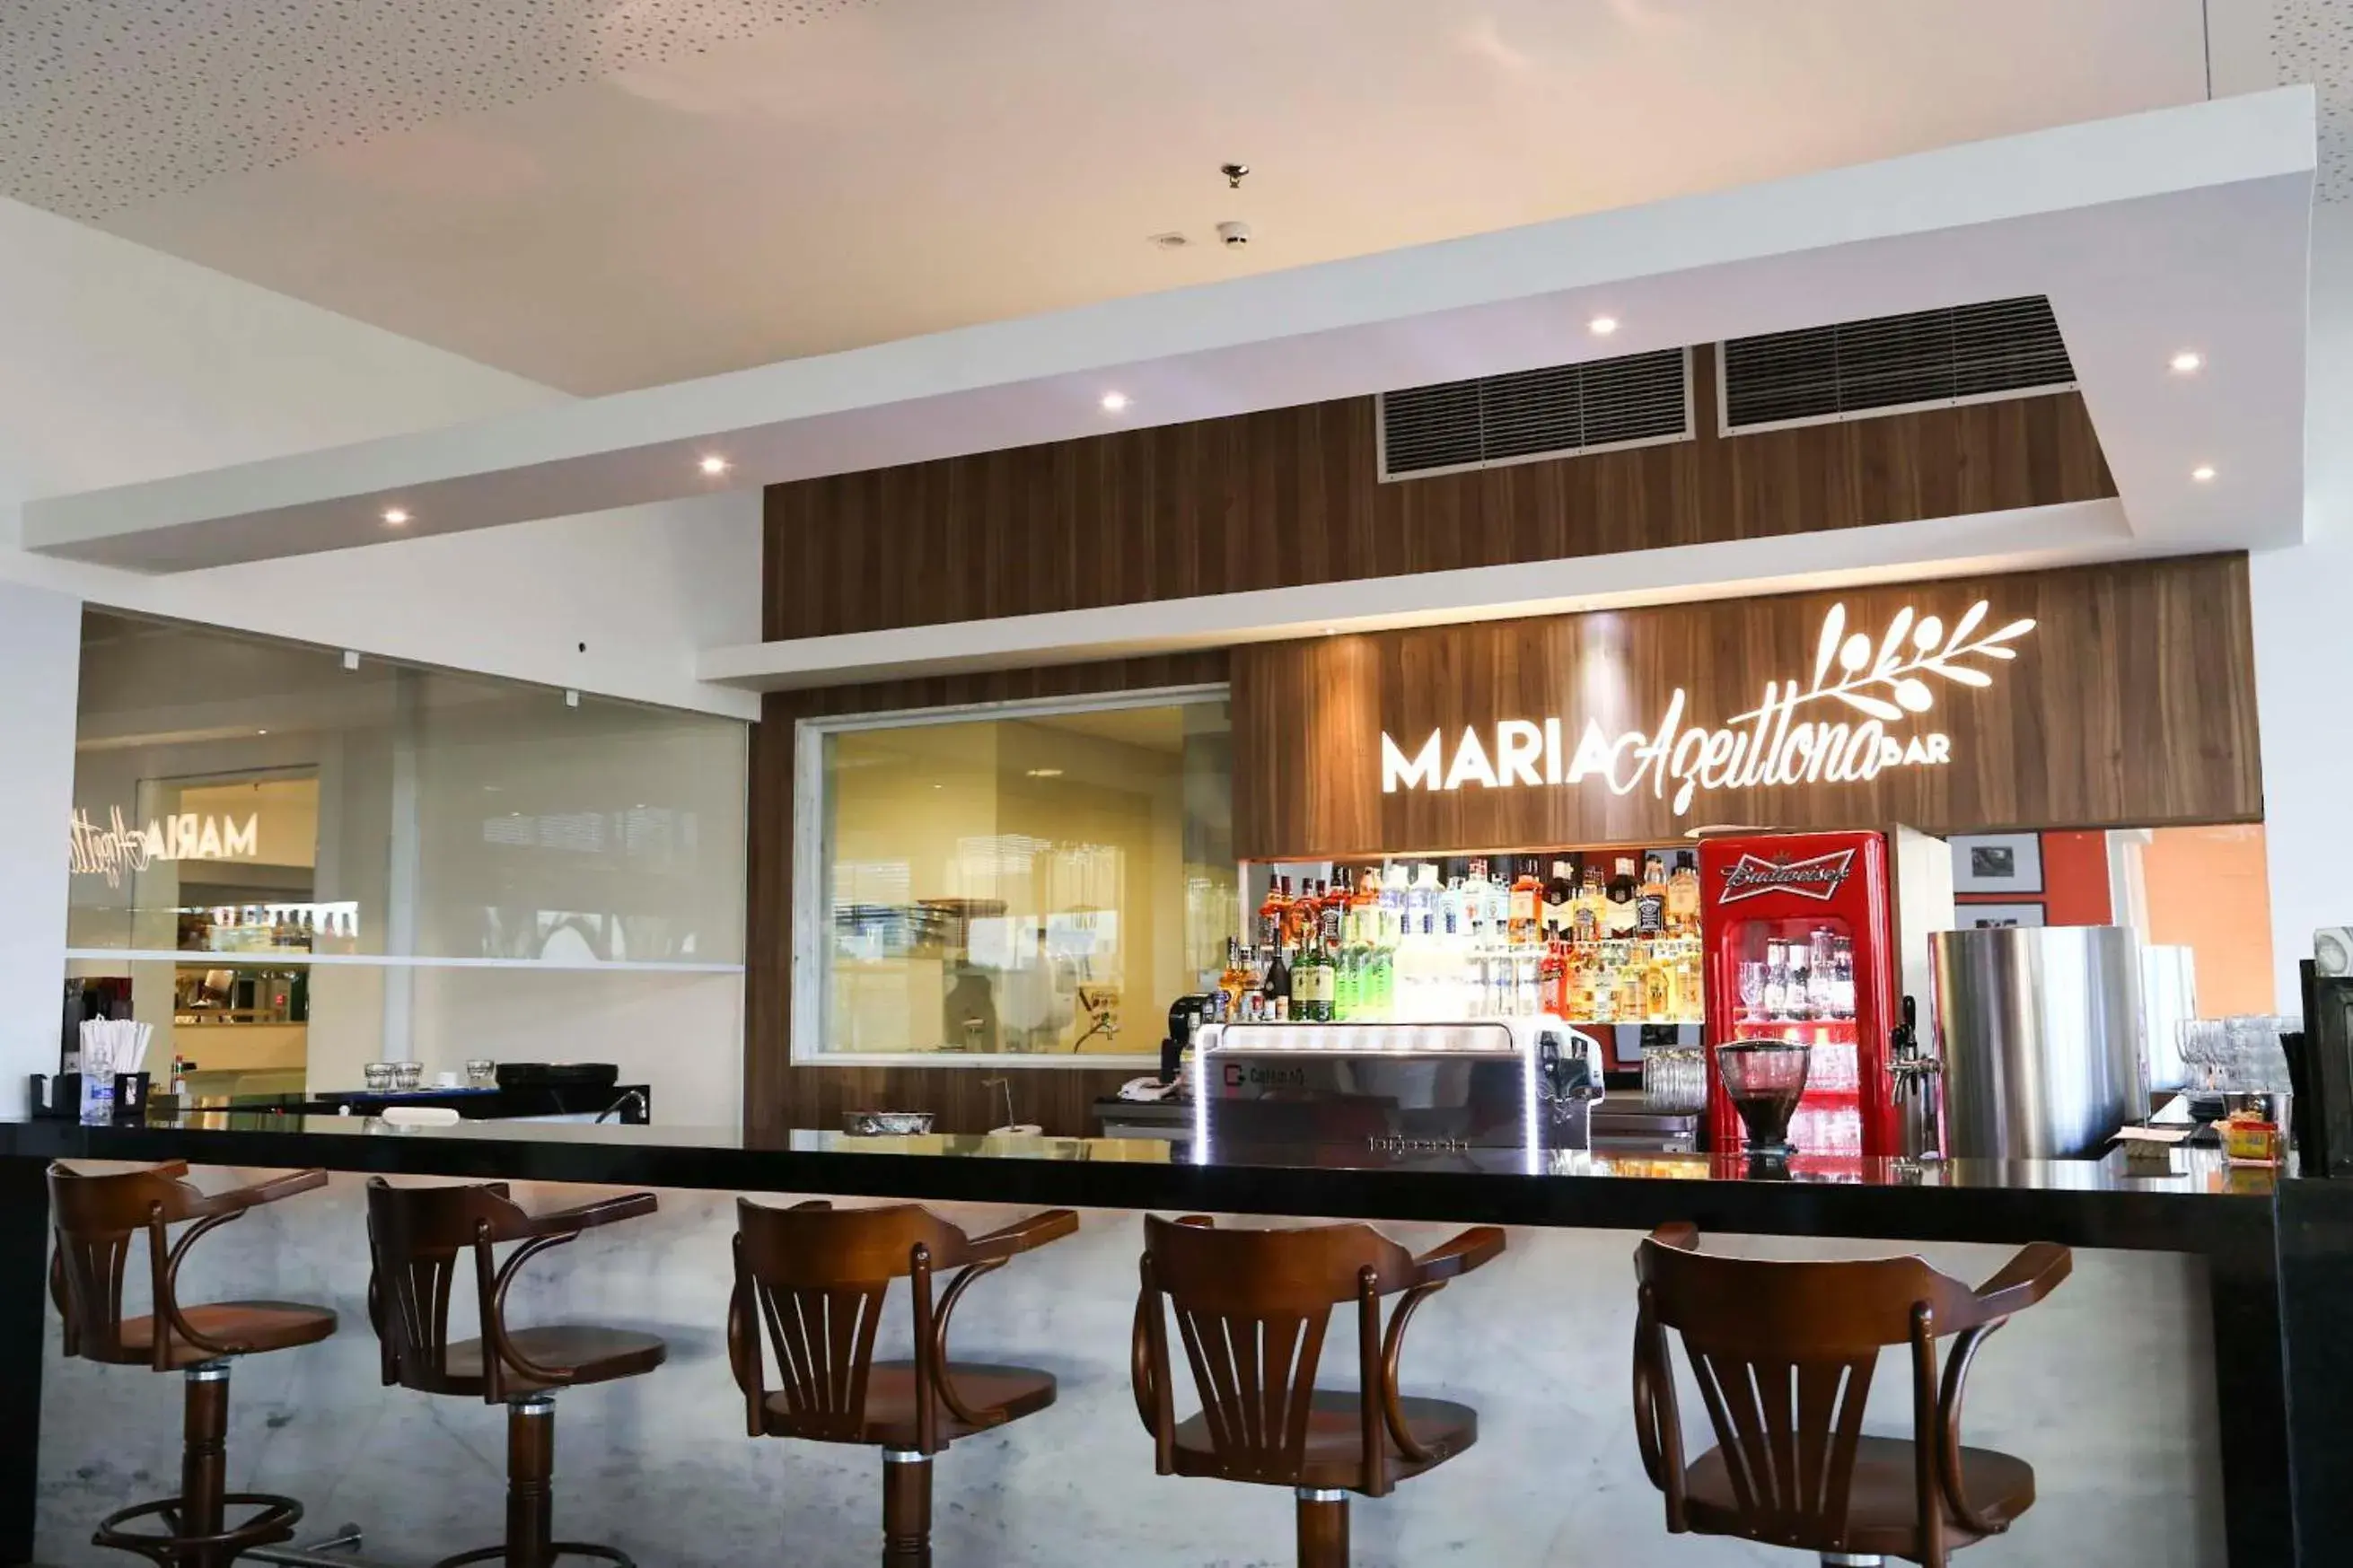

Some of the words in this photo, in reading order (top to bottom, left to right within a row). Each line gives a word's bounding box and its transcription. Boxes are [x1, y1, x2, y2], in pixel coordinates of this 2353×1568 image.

[1381, 717, 1611, 793] MARIA
[1880, 733, 1951, 766] BAR
[1720, 864, 1849, 888] Budweiser
